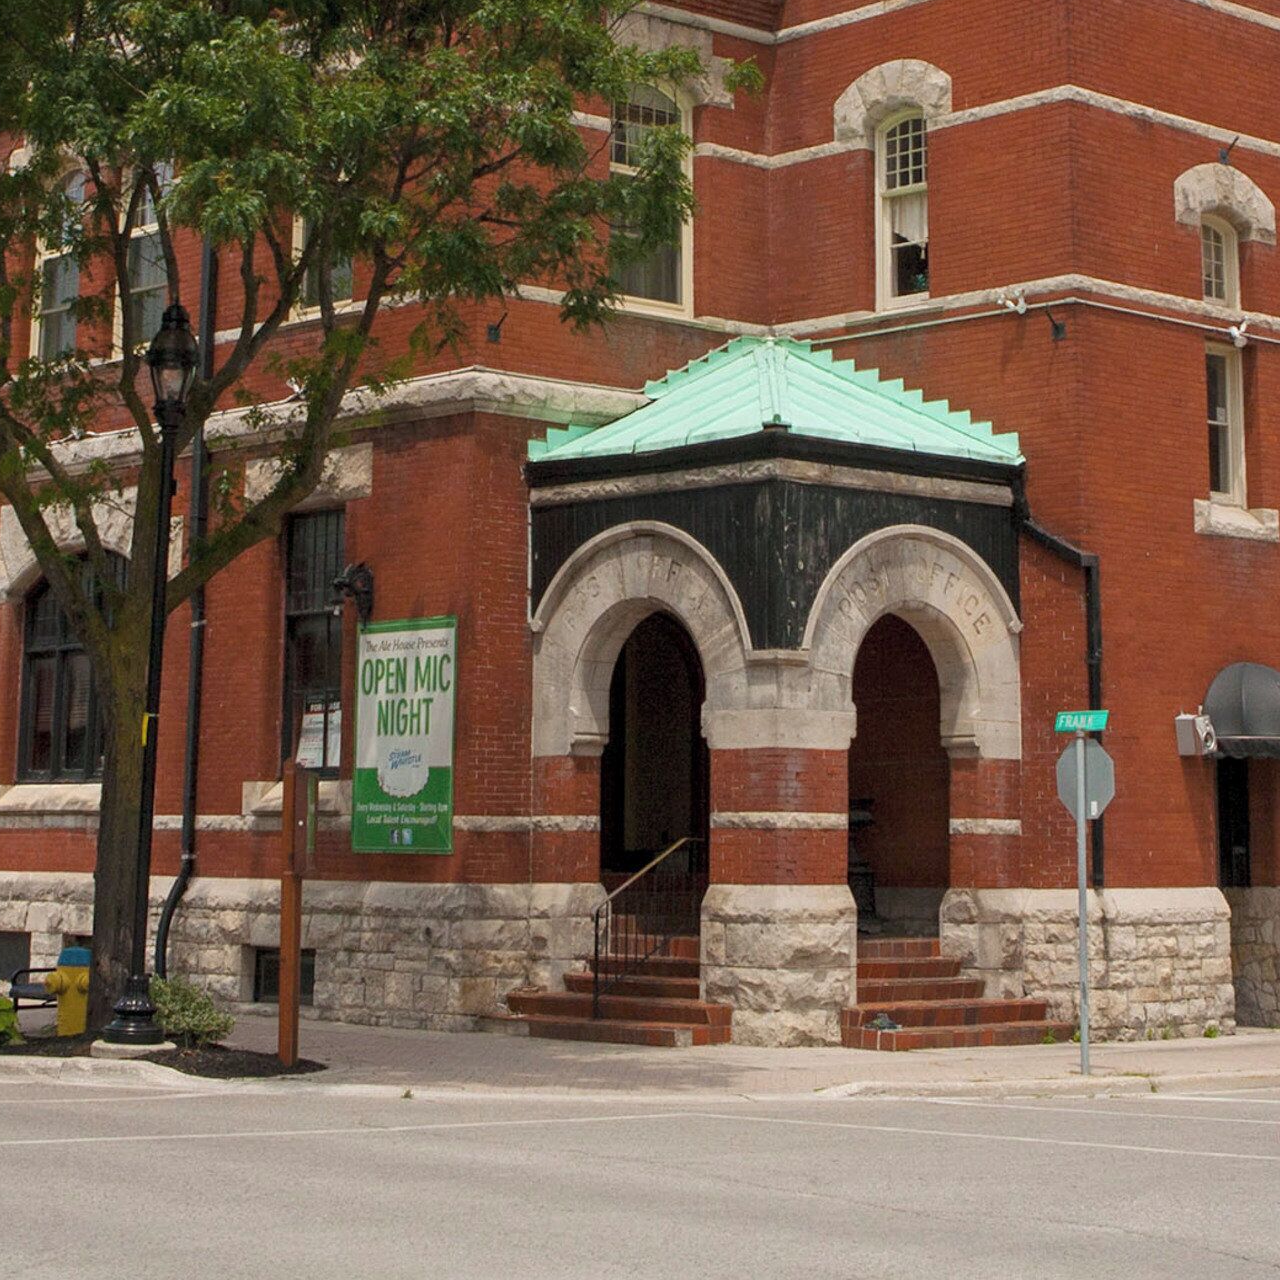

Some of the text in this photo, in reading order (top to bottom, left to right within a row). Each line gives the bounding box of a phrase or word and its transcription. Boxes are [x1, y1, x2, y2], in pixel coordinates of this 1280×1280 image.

[838, 558, 992, 635] POST OFFICE
[366, 636, 451, 653] The Ale House Presents
[361, 653, 451, 696] OPEN MIC
[377, 697, 434, 737] NIGHT
